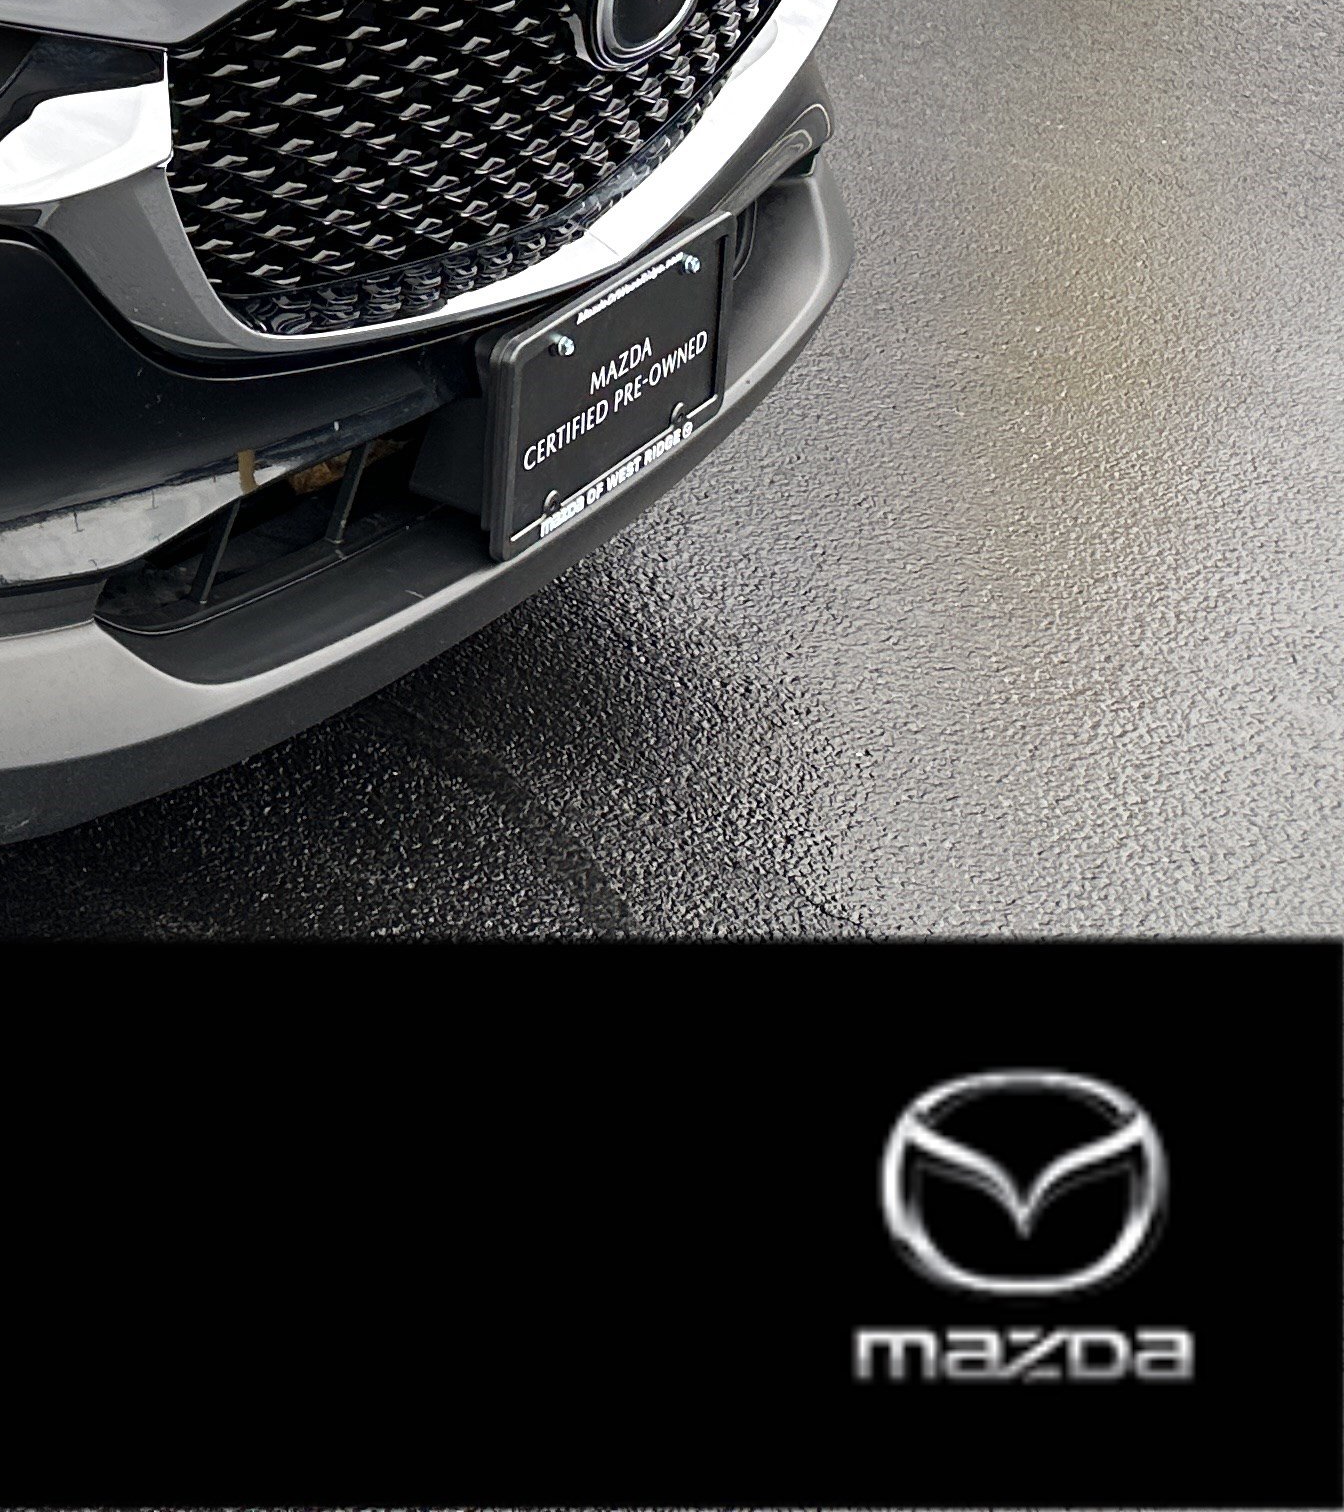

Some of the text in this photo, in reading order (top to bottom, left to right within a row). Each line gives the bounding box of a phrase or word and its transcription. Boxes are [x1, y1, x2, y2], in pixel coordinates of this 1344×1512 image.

[523, 330, 708, 471] CERTIFIED PRE-OWNED
[589, 336, 653, 395] MAZDA
[586, 481, 605, 506] OF
[606, 455, 643, 492] WEST
[643, 428, 682, 466] RIDGE
